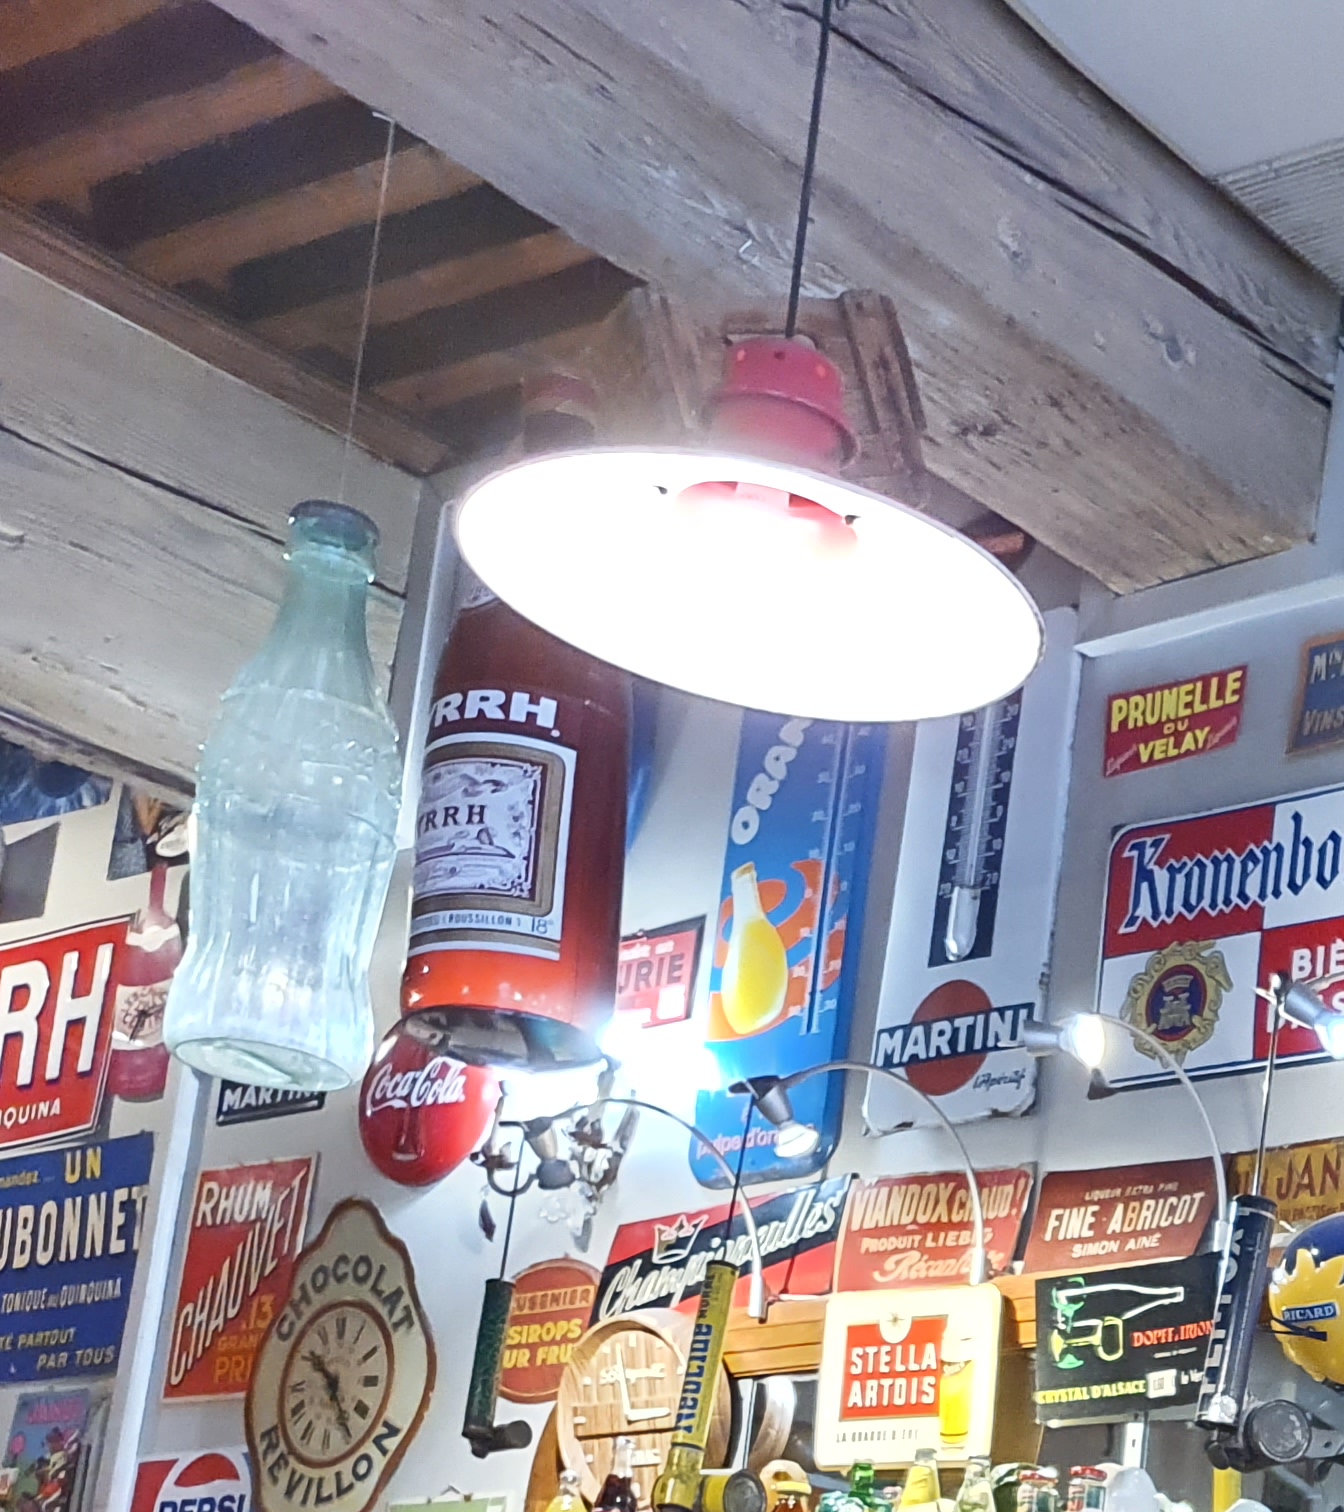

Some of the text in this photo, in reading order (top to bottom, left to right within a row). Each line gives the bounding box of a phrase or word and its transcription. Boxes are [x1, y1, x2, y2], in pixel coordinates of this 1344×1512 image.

[1111, 670, 1243, 733] PRUNELLE
[1139, 726, 1210, 763] VELAY
[1164, 719, 1187, 735] DU
[367, 1056, 467, 1108] Coca-Cola
[64, 1147, 101, 1183] UN
[196, 1180, 273, 1228] RHUM
[851, 1182, 956, 1231] VIANDOX
[1045, 1192, 1205, 1241] FINE ABRICOT
[861, 1235, 922, 1253] PRODUIT
[1071, 1232, 1161, 1258] SIMON AINÉ
[170, 1167, 307, 1386] CHAUVET
[274, 1254, 417, 1341] CHOCOLAT
[1283, 1303, 1336, 1321] RICARD
[18, 1327, 76, 1346] PARTOUT
[508, 1319, 583, 1345] SIROPS
[37, 1346, 115, 1371] PAR TOUS
[851, 1343, 937, 1375] STELLA
[848, 1376, 936, 1408] ARTOIS
[260, 1419, 402, 1506] REVILLON
